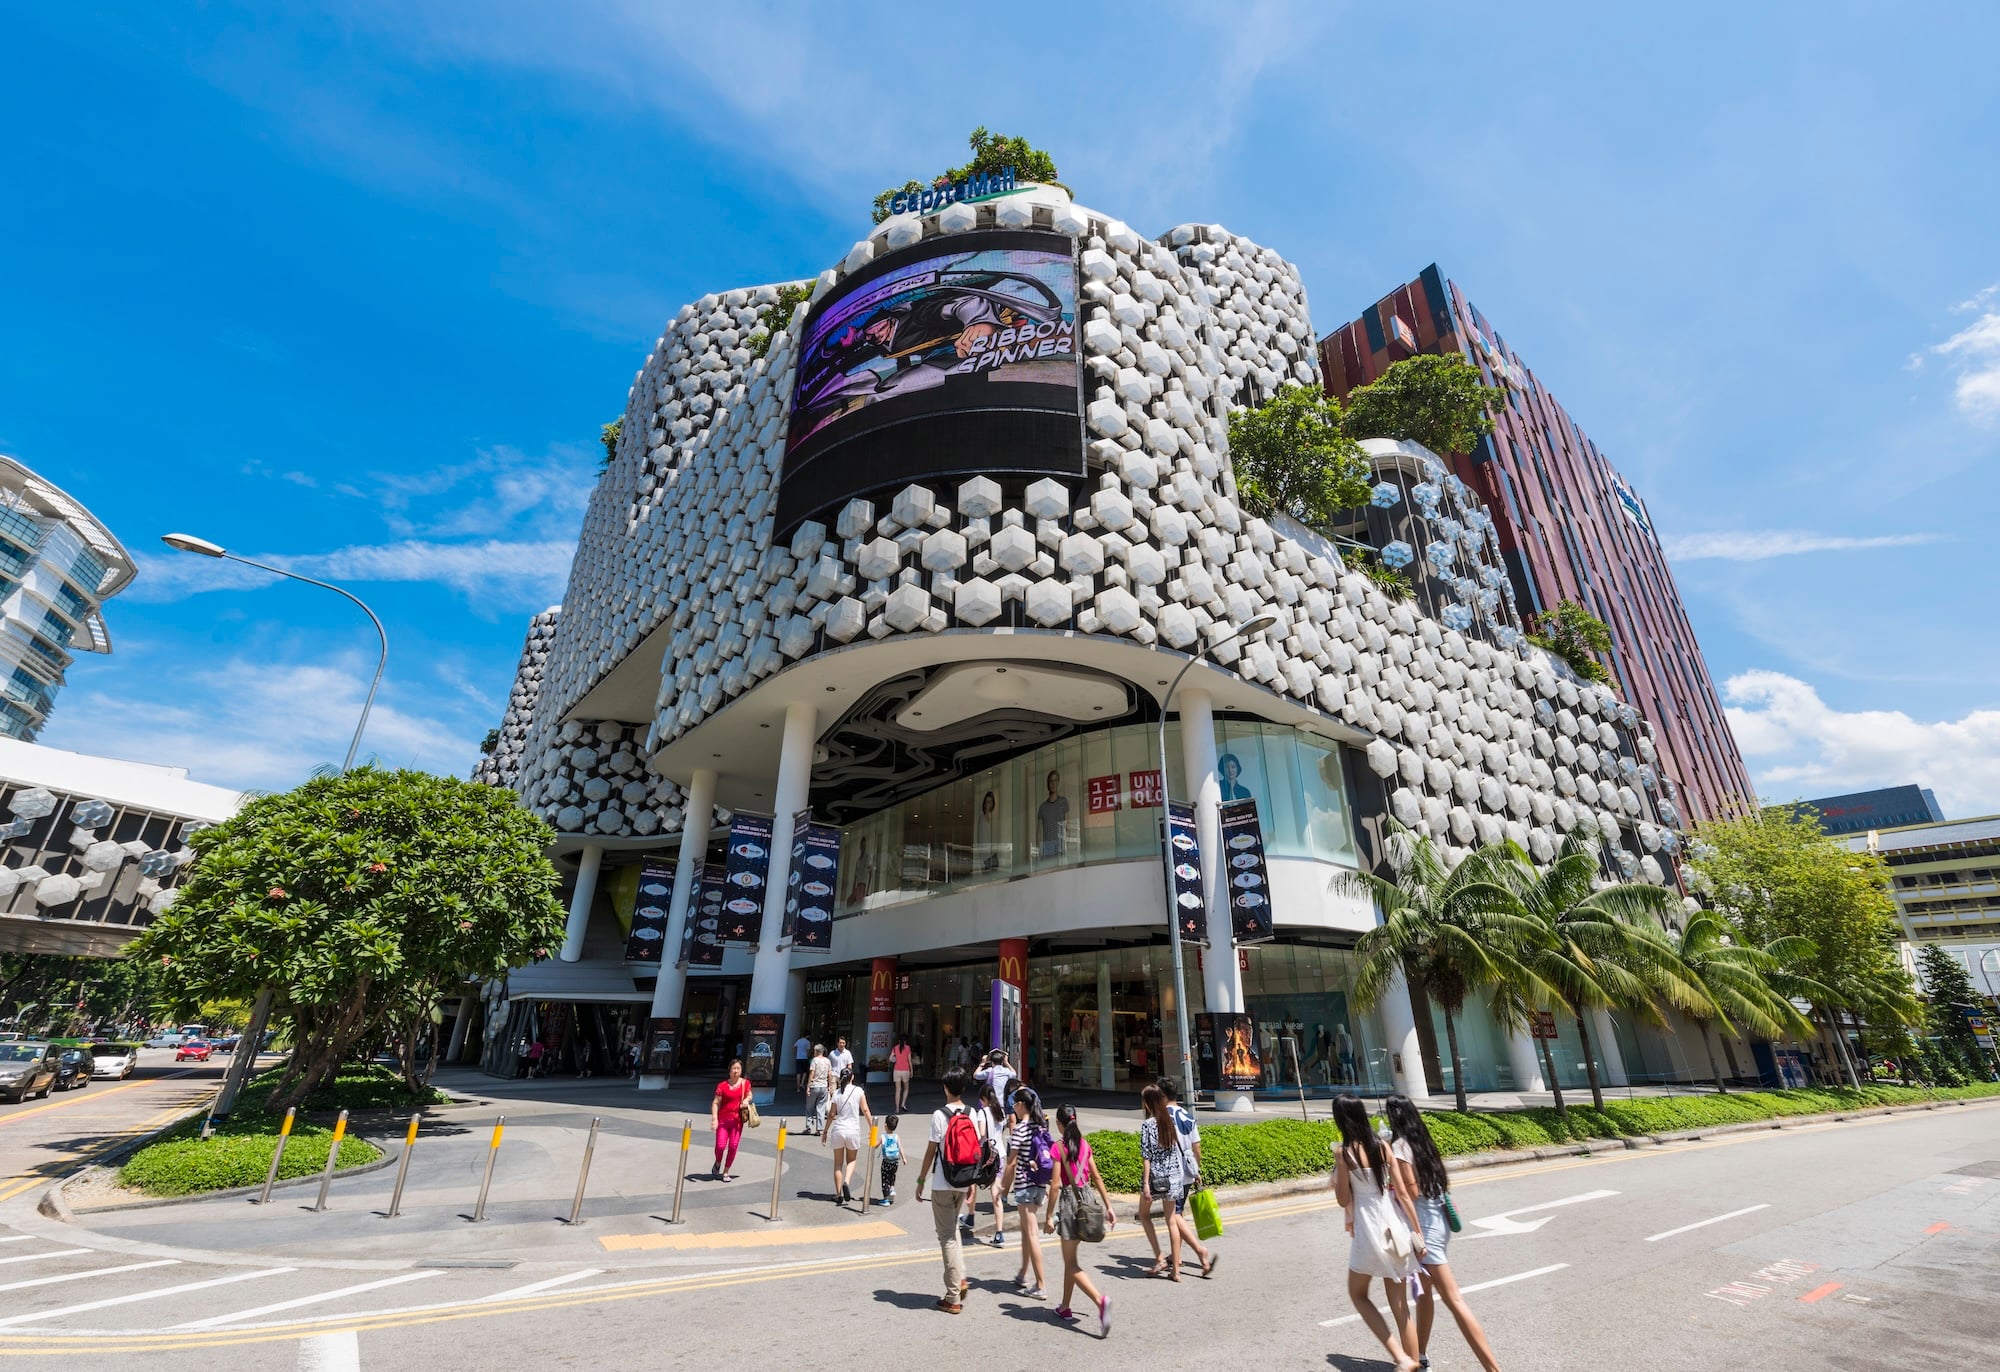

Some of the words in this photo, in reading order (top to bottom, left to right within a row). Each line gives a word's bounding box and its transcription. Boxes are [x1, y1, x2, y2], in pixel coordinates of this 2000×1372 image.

[891, 166, 1015, 215] CapitaMall
[968, 319, 1075, 356] RIBBON
[956, 337, 1072, 374] SPINNER
[1133, 774, 1160, 788] UNI
[1135, 789, 1162, 806] QLO
[871, 1041, 889, 1049] CHICK
